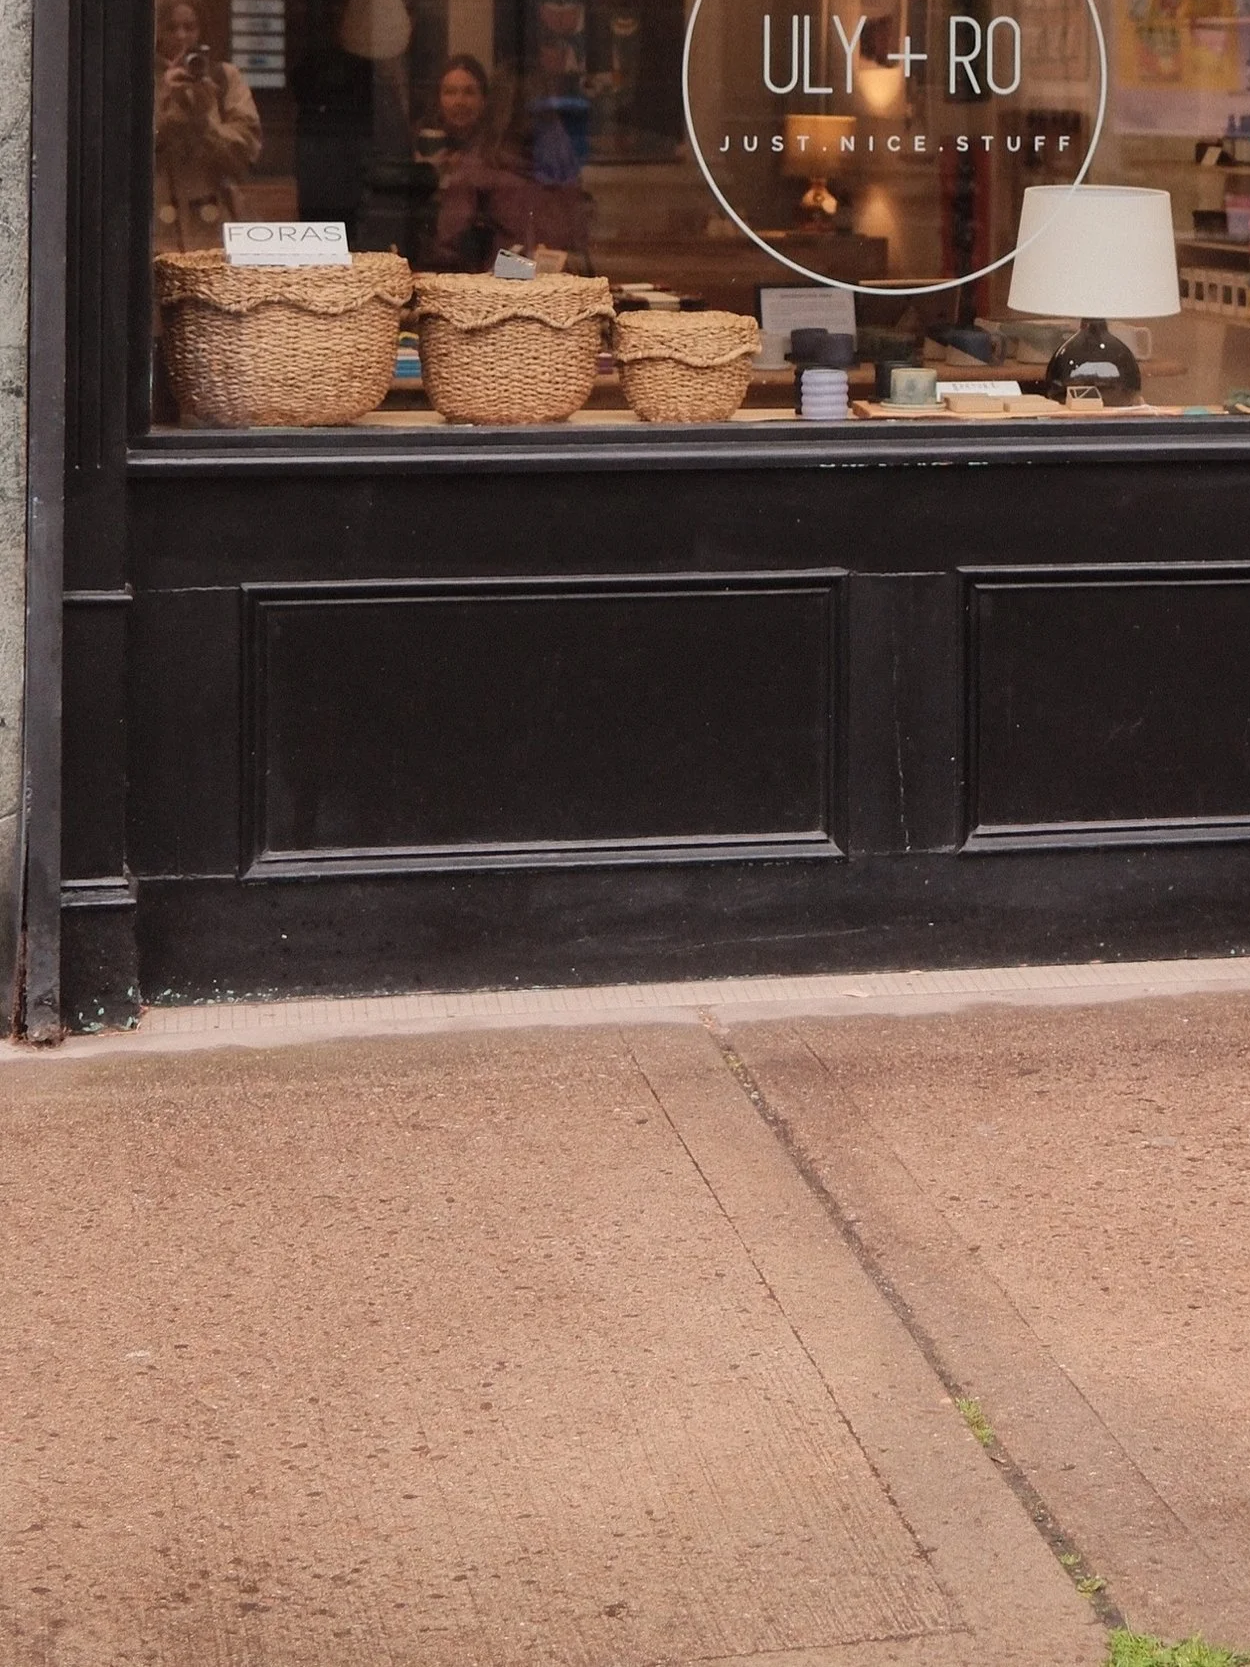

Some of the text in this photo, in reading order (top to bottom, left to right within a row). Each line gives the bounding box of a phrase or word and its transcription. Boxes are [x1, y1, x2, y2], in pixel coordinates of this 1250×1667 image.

[763, 14, 1022, 95] ULY + RO
[228, 225, 342, 243] FORAS
